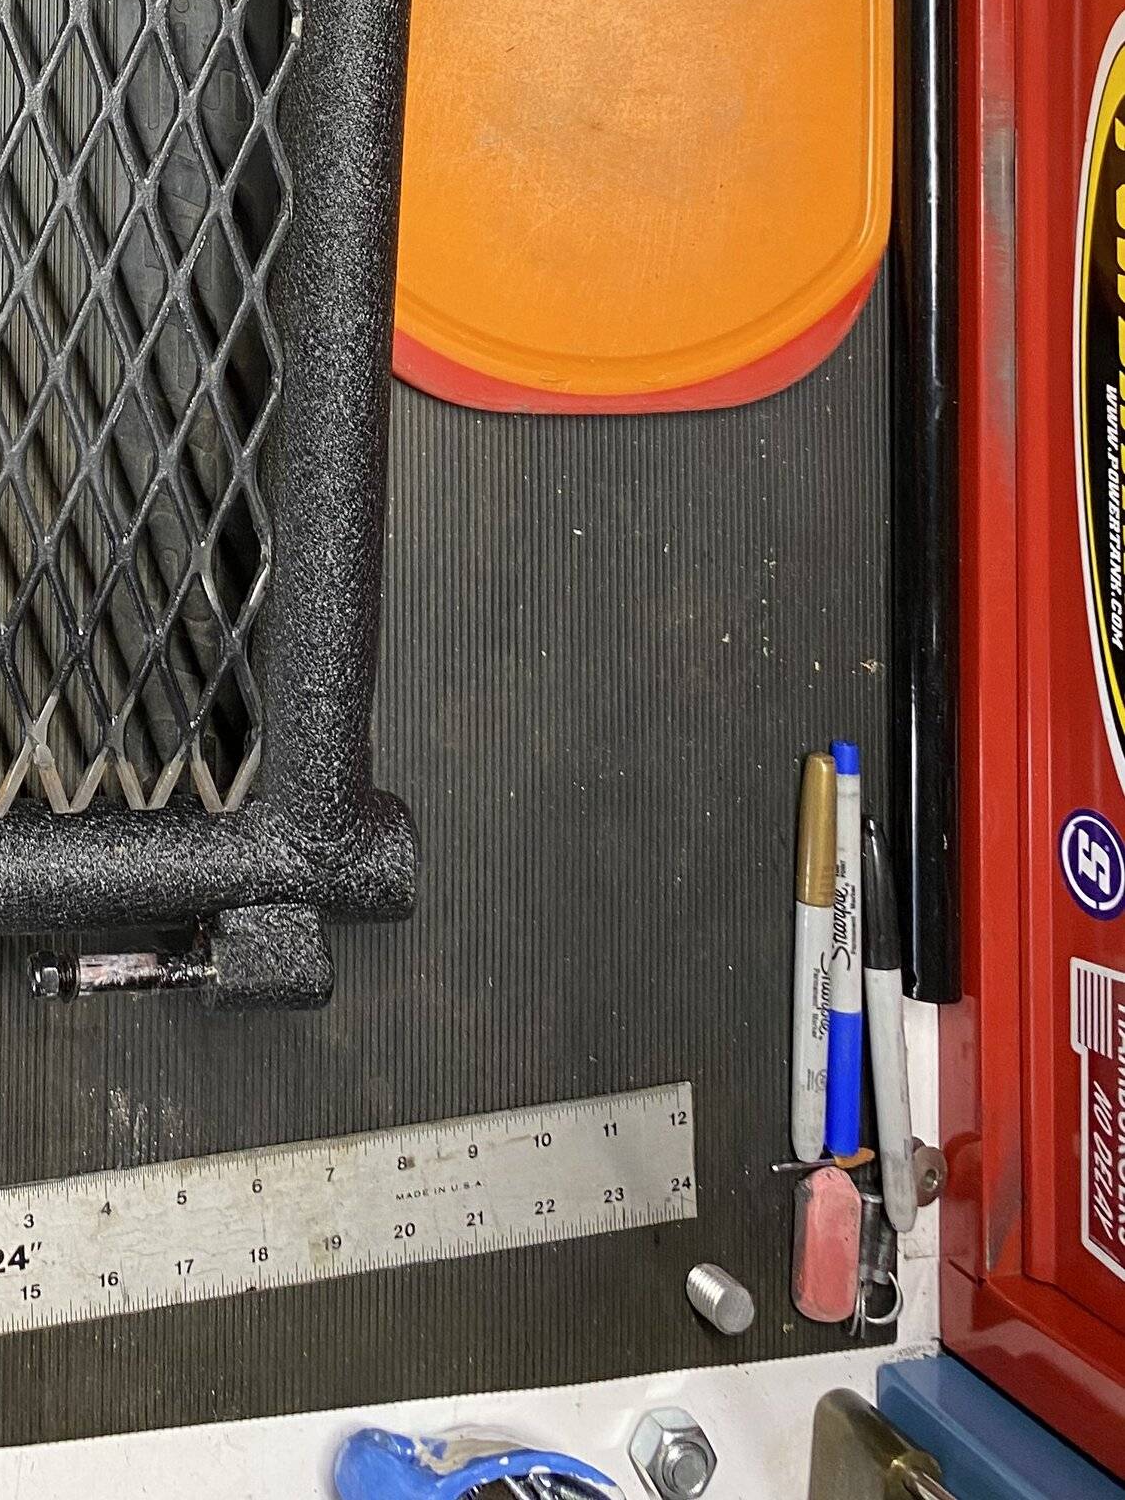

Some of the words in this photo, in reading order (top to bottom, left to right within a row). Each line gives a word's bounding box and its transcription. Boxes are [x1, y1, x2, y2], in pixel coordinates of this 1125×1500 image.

[1105, 383, 1125, 650] WWW.POWERTANK.COM
[1094, 1080, 1113, 1136] NO
[24, 1214, 34, 1228] 3
[101, 1202, 111, 1215] 4
[177, 1190, 187, 1205] 5
[252, 1179, 262, 1193] 6
[326, 1167, 334, 1182] 7
[397, 1156, 407, 1171] 8
[468, 1145, 477, 1158] 9
[534, 1133, 551, 1148] 10
[603, 1123, 617, 1137] 11
[671, 1111, 687, 1126] 12
[1094, 1131, 1114, 1240] DELAY
[21, 1284, 41, 1300] 15
[99, 1272, 118, 1287] 16
[175, 1259, 193, 1275] 17
[249, 1247, 268, 1263] 18
[323, 1235, 342, 1250] 19
[394, 1223, 415, 1239] 20
[467, 1211, 483, 1227] 21
[535, 1199, 555, 1215] 22
[604, 1188, 624, 1203] 23
[671, 1176, 691, 1192] 24
